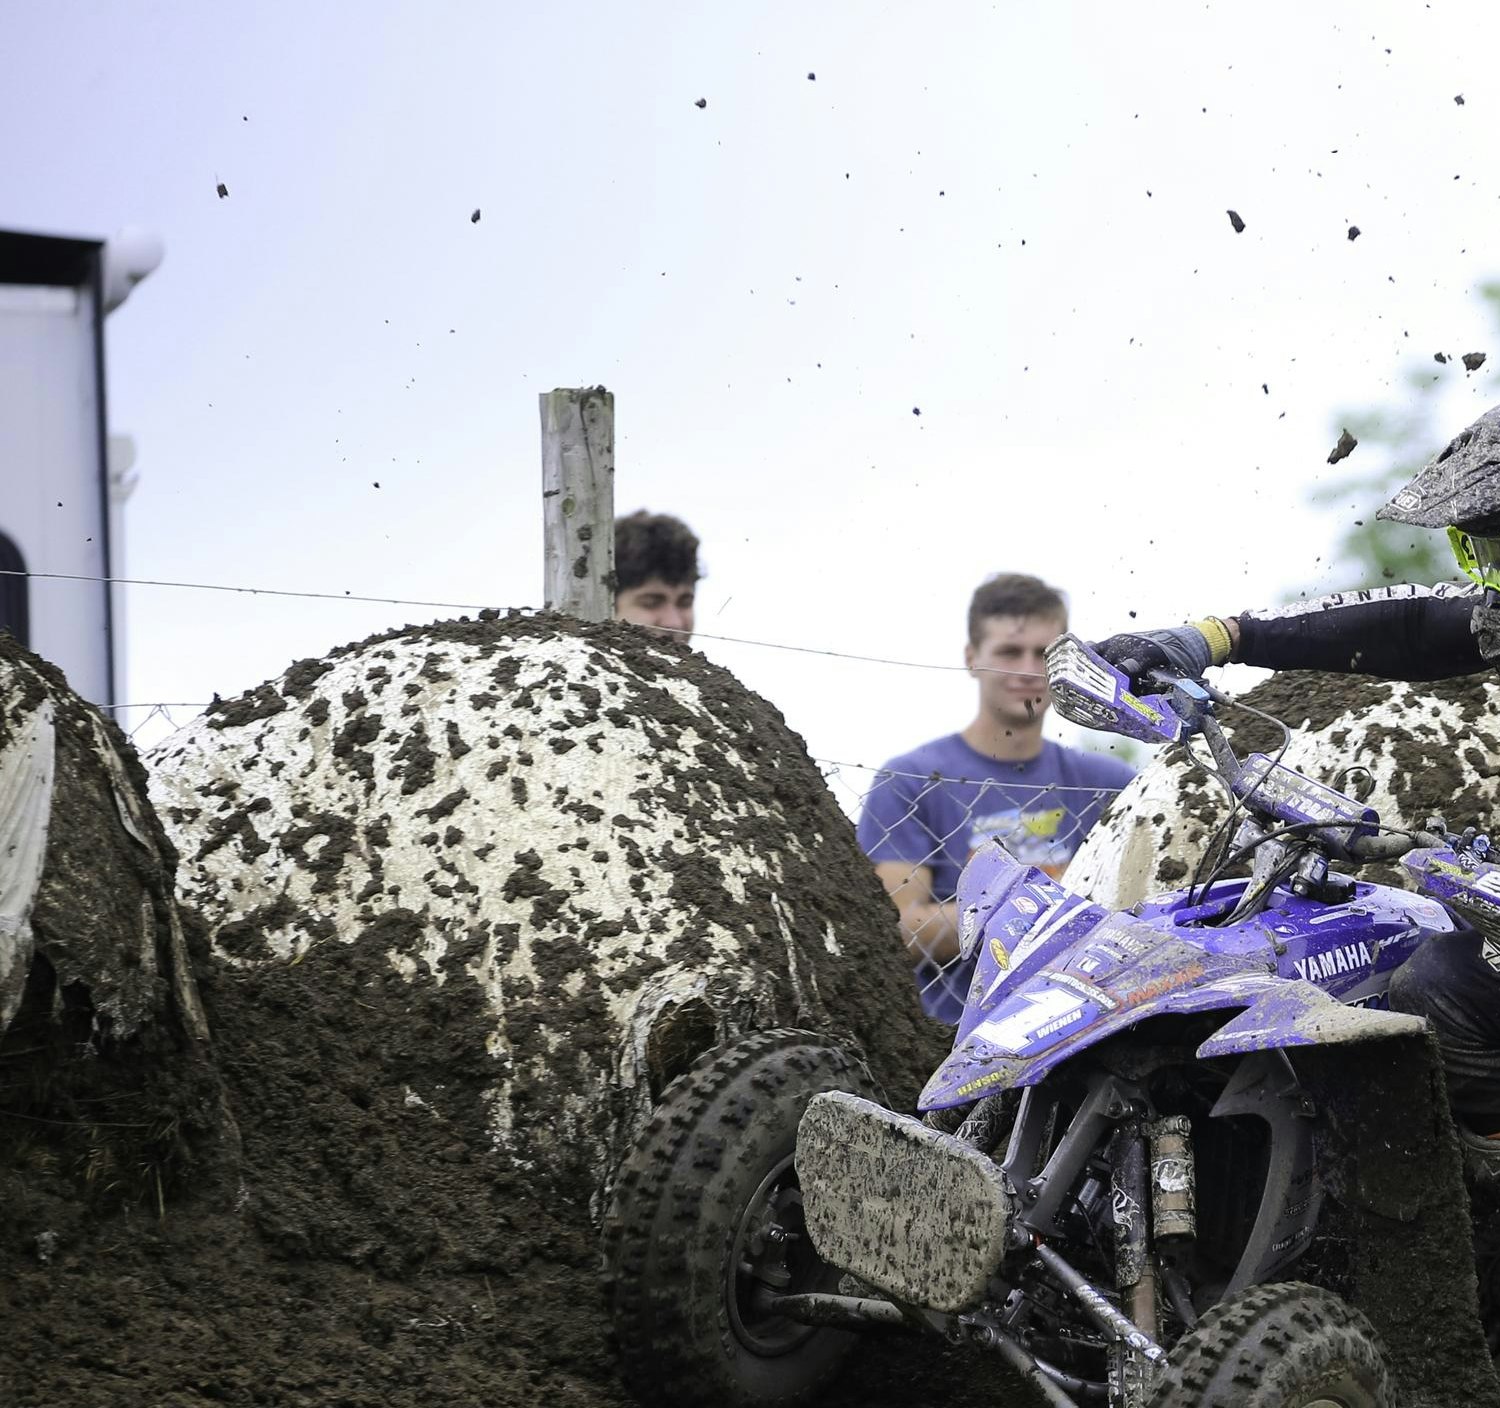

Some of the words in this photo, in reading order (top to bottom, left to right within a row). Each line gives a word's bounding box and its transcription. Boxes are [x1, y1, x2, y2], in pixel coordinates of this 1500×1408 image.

[1294, 941, 1372, 981] YAMAHA
[968, 987, 1089, 1053] 1
[1036, 1009, 1083, 1039] WIENEN
